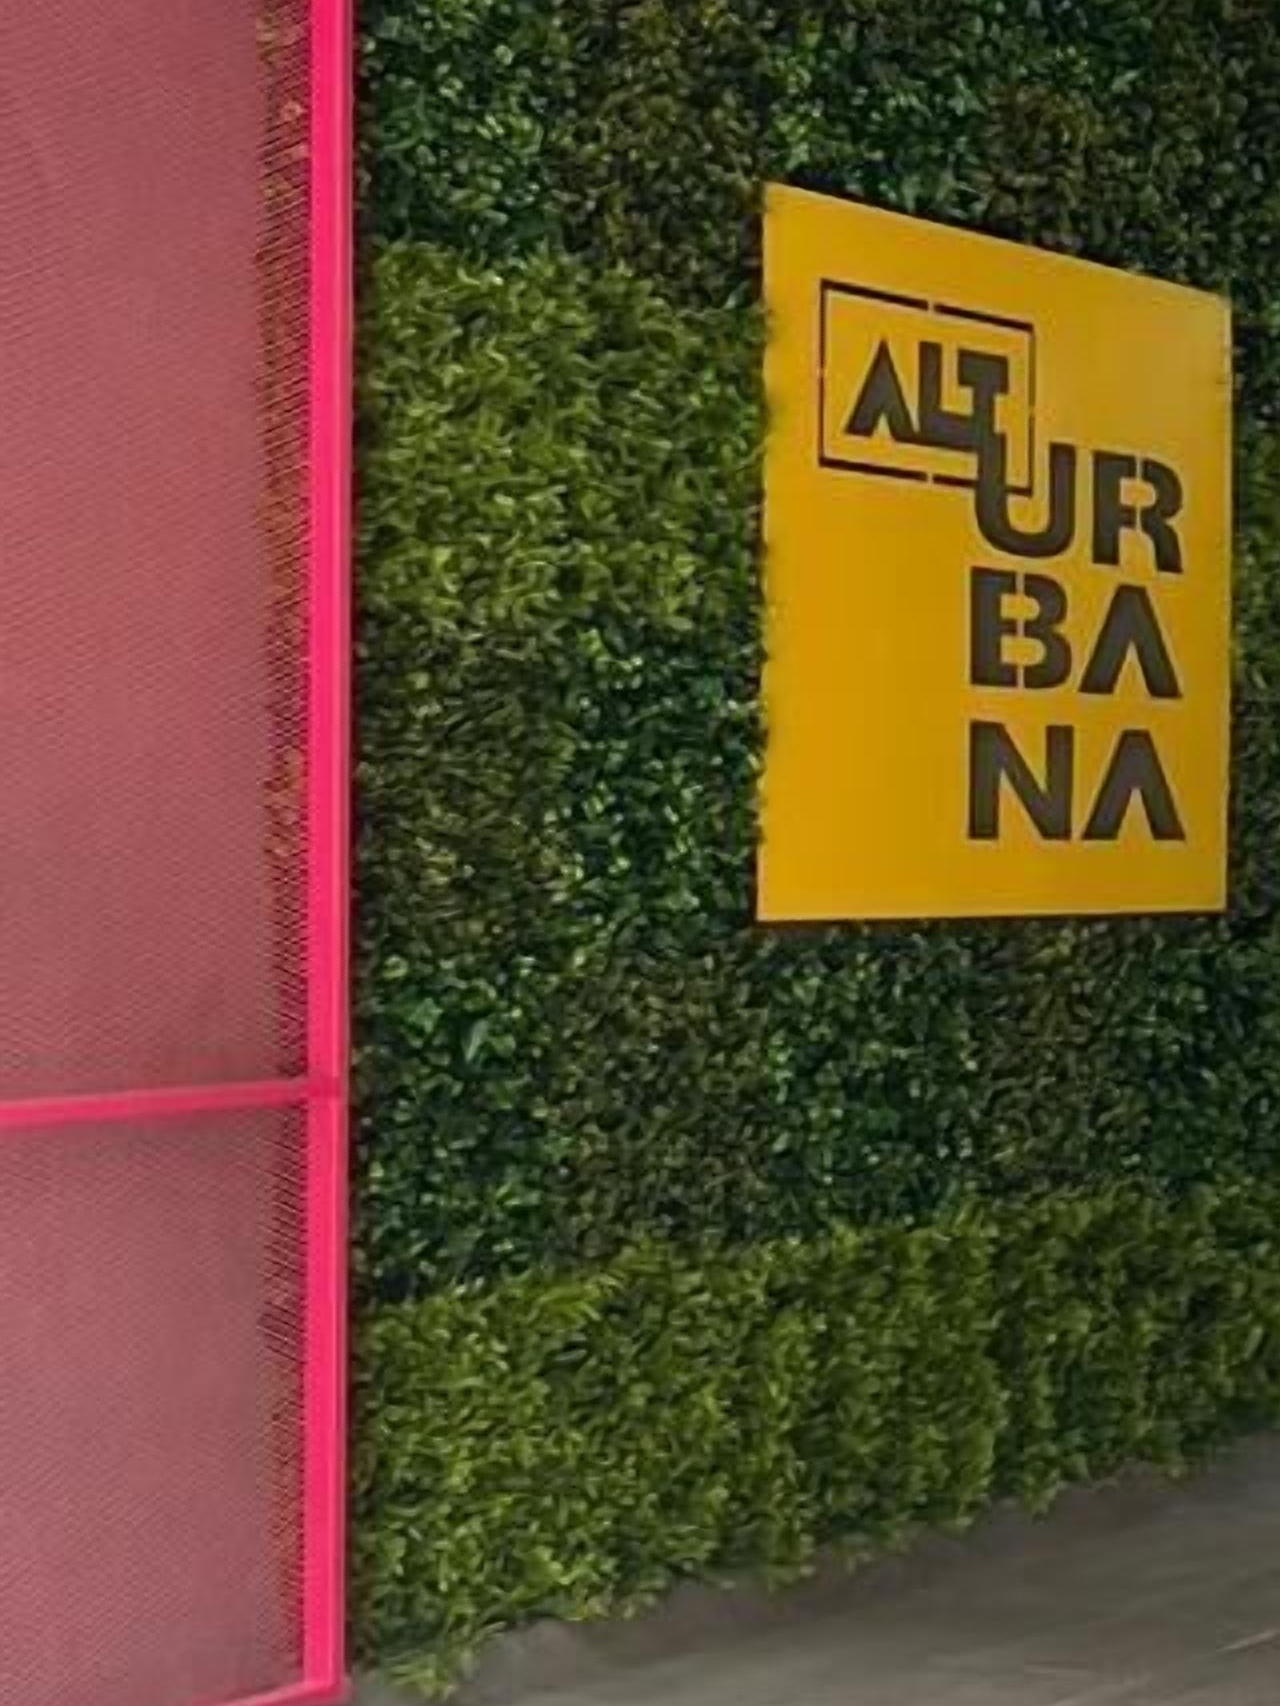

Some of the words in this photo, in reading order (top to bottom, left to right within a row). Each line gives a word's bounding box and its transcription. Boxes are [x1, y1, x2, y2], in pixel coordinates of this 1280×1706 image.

[845, 339, 1010, 453] ALT
[975, 443, 1184, 574] UR
[969, 567, 1182, 698] BA
[968, 720, 1186, 842] NA
